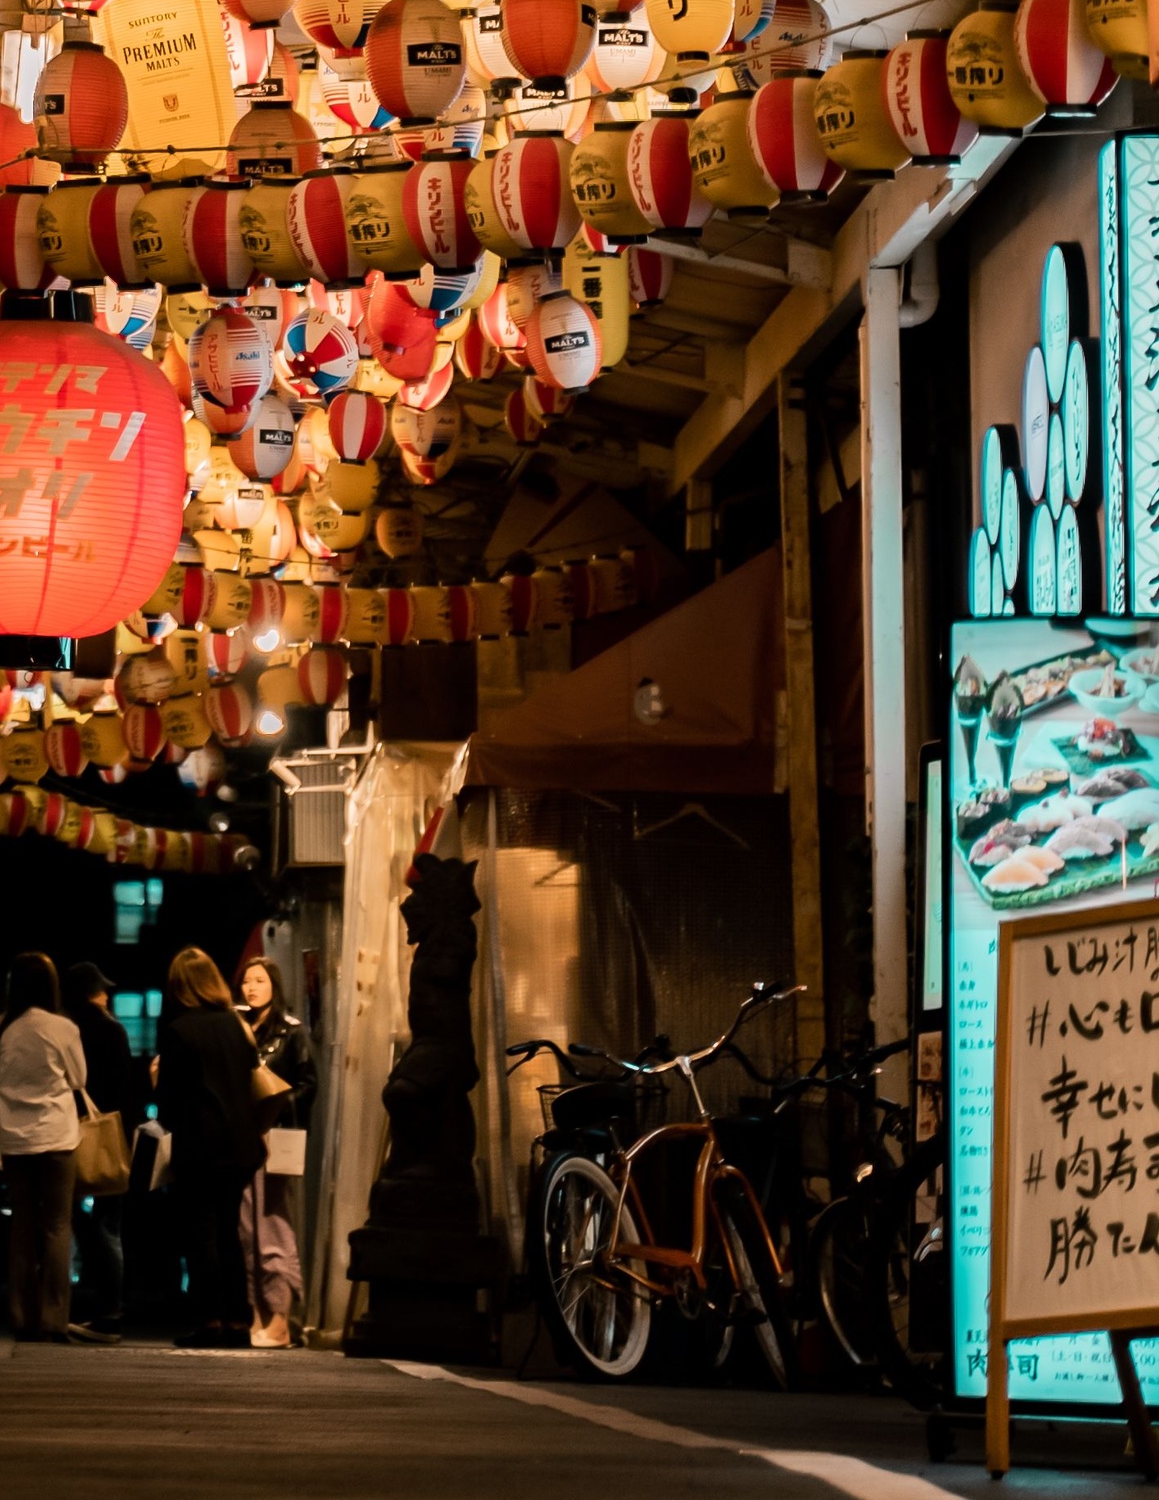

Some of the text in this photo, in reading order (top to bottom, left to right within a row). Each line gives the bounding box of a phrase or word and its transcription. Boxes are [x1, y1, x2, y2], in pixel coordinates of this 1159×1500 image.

[129, 11, 178, 30] SUNTORY
[145, 27, 166, 41] The
[604, 32, 644, 44] MALT'S
[123, 32, 197, 66] PREMIUM
[417, 49, 457, 61] MALT'S
[146, 56, 180, 73] MALT'S
[501, 151, 520, 233] キリンビール
[427, 177, 450, 254] キリンビール
[551, 336, 585, 349] MALT'S
[968, 1349, 1040, 1382] 肉司
